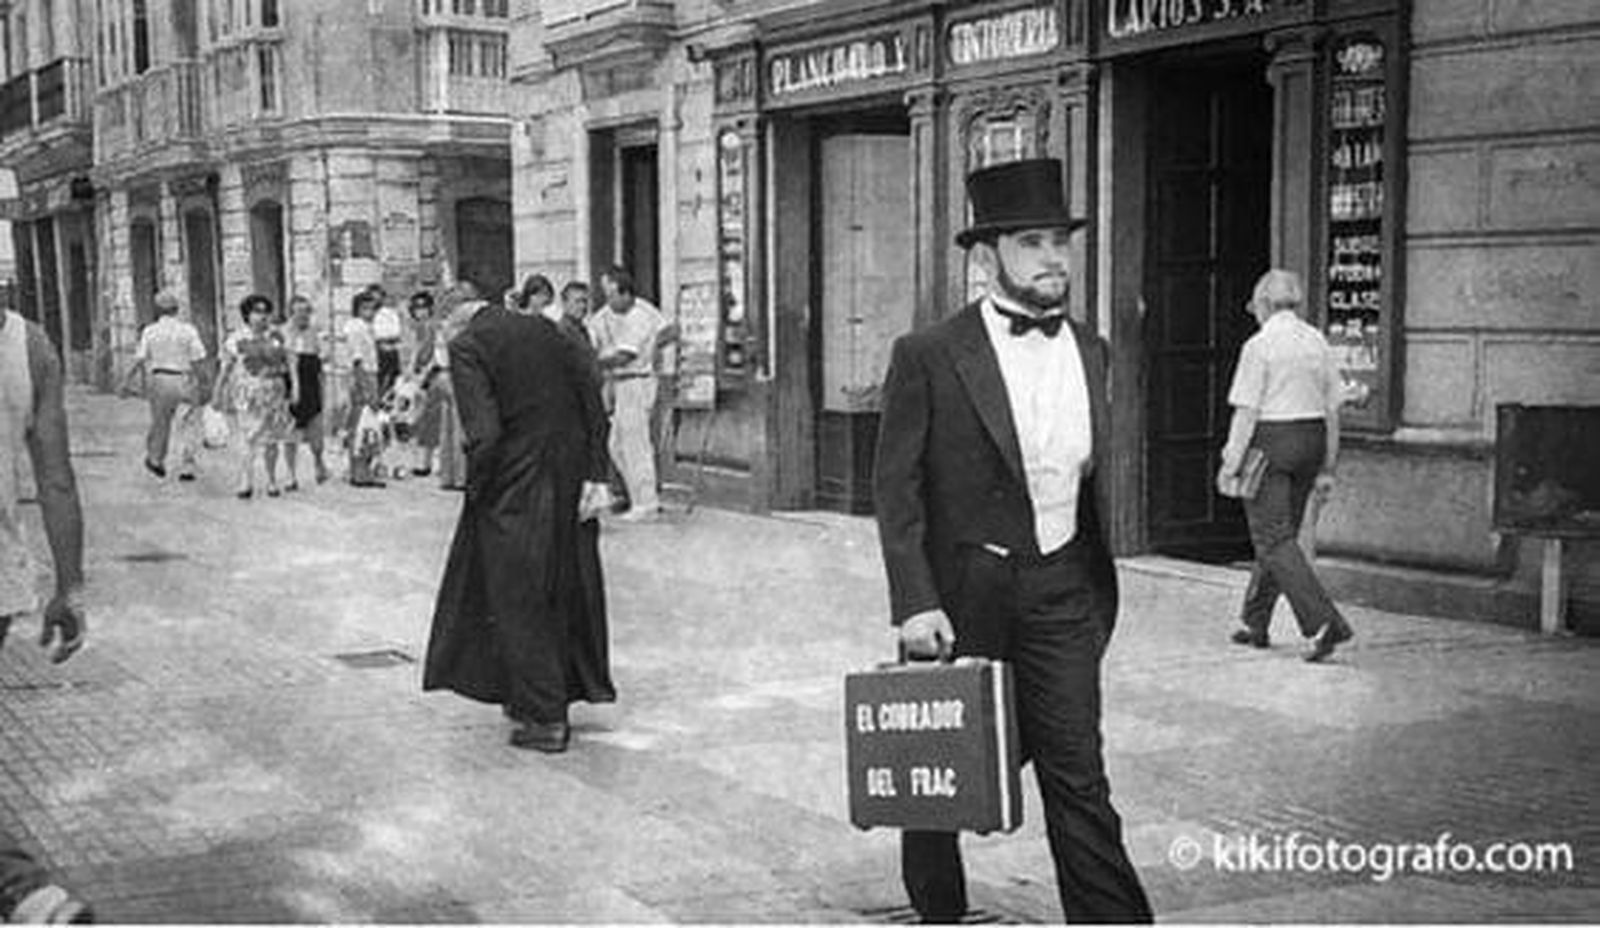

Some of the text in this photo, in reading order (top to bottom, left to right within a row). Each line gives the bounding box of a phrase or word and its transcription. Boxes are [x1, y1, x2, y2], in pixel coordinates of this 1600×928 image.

[856, 703, 875, 732] EL
[867, 766, 958, 798] DEL FRAC
